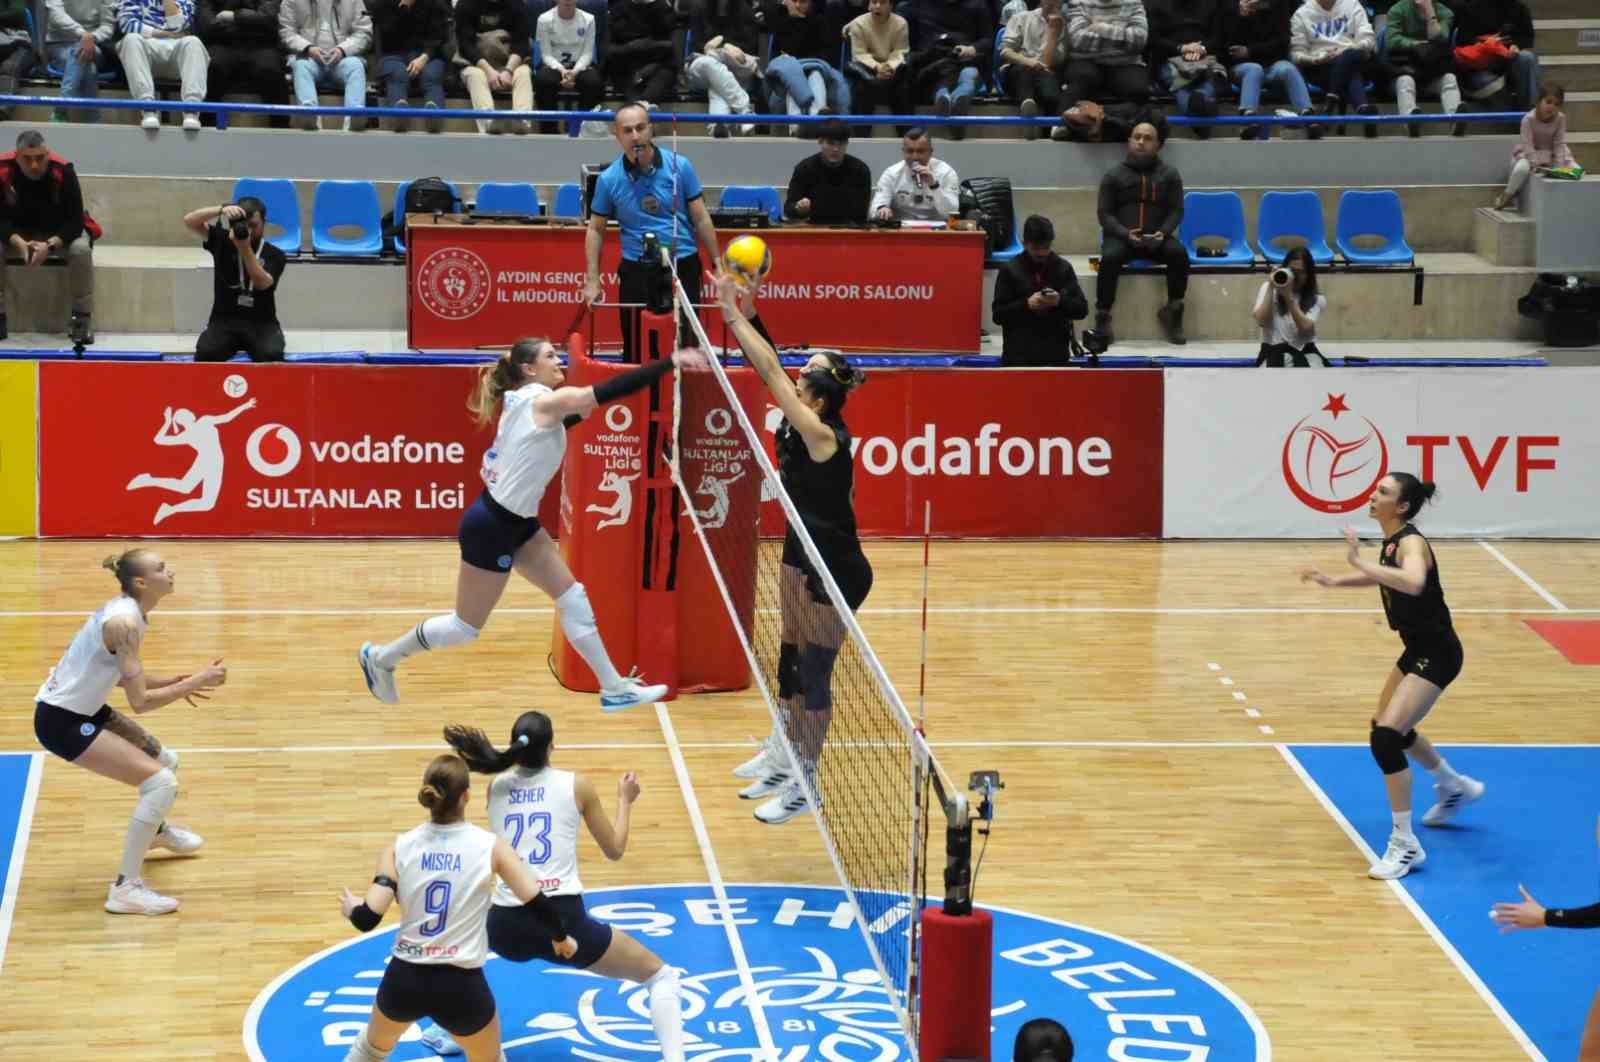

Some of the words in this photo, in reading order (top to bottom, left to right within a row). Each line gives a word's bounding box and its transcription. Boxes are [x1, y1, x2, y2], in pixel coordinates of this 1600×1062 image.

[497, 271, 541, 284] AYDIN
[543, 271, 605, 287] GENÇK
[496, 288, 509, 303] İL
[512, 288, 606, 303] MÜDÜRLÜ
[758, 281, 810, 299] SİNAN
[815, 285, 861, 300] SPOR
[864, 285, 933, 300] SALONU
[596, 433, 640, 443] vodafone
[310, 434, 465, 463] vodafone
[583, 443, 641, 457] SULTANL
[1406, 436, 1560, 492] TVF
[246, 488, 401, 508] SULTANLAR
[415, 482, 465, 509] LİGİ
[508, 786, 545, 805] SEHER
[421, 853, 462, 872] MISRA
[536, 877, 560, 889] OTO
[419, 880, 452, 937] 9
[706, 1020, 742, 1035] 18
[782, 1019, 816, 1033] 81
